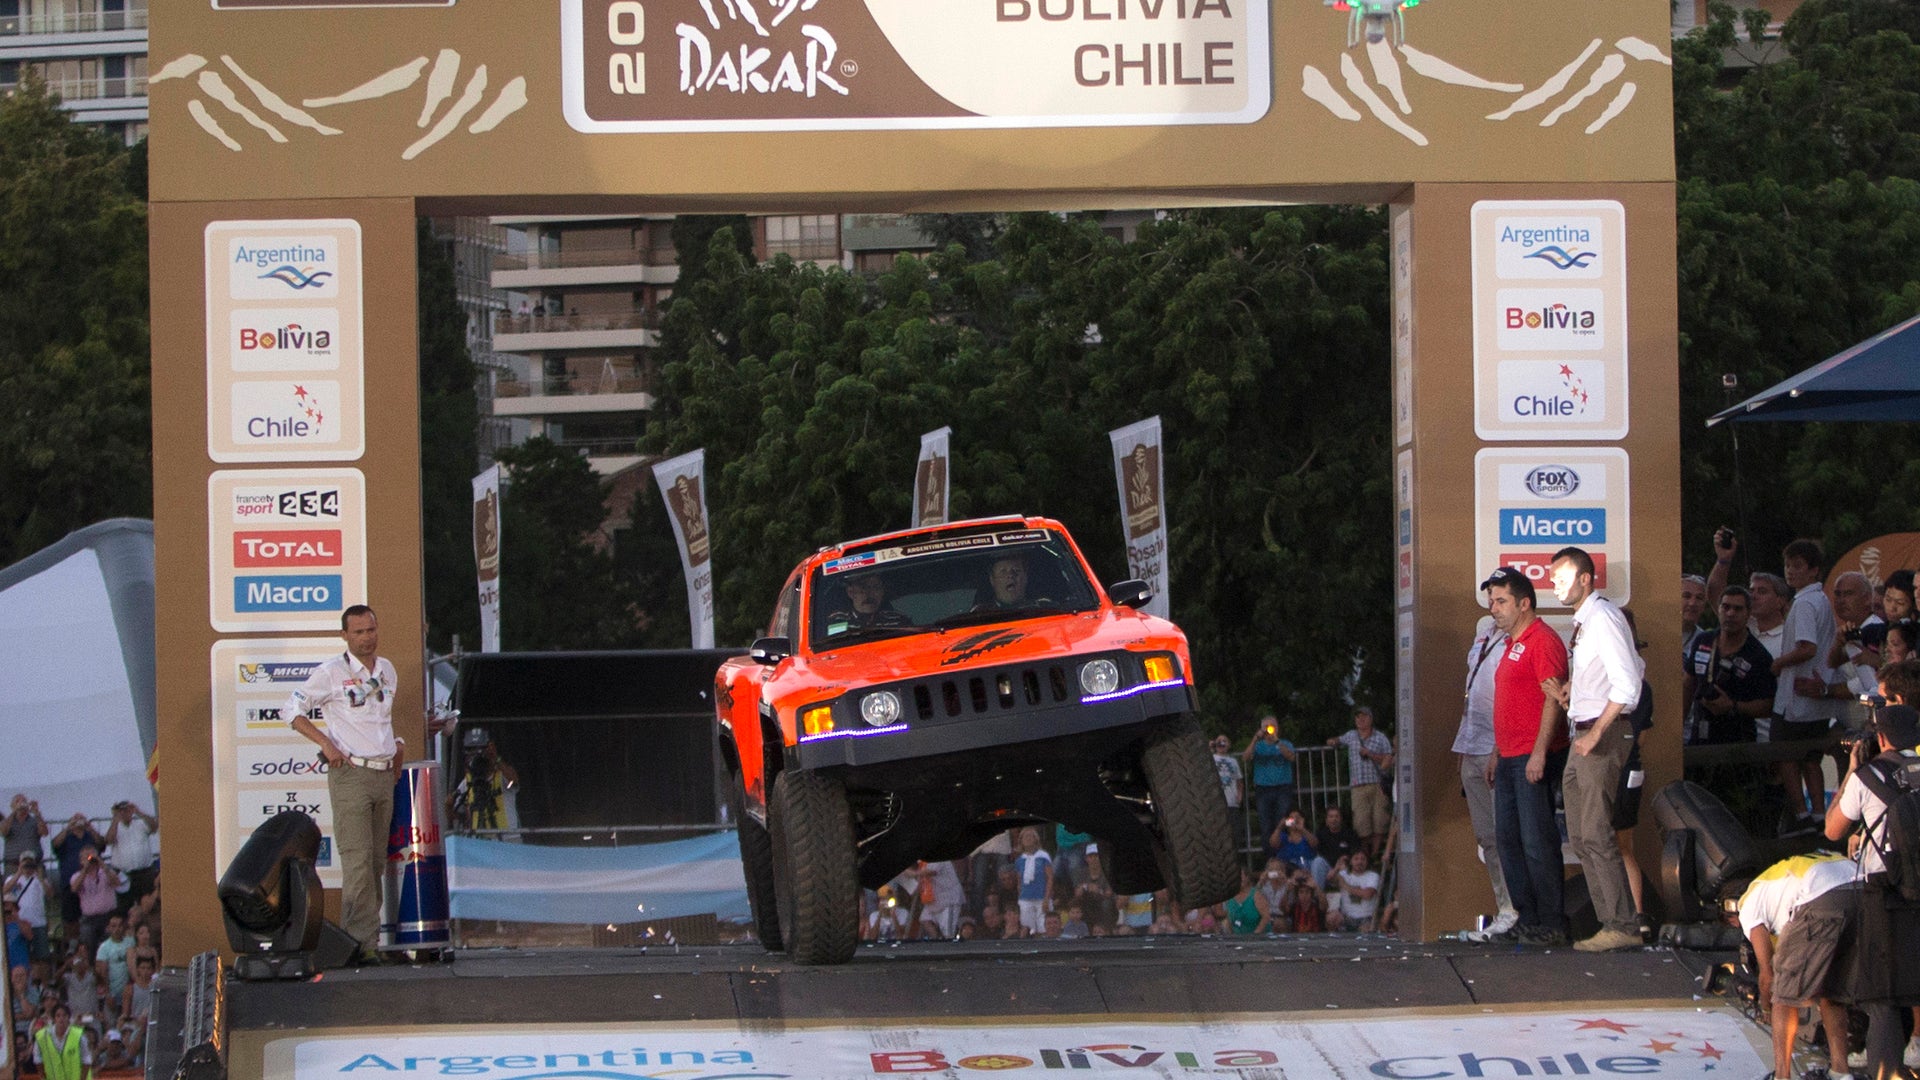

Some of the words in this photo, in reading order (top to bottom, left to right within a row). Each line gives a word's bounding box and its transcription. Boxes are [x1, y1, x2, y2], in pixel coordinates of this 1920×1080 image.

[675, 22, 850, 97] DAKAR
[1073, 41, 1235, 87] CHILE
[1501, 225, 1590, 248] Argentina
[235, 244, 326, 268] Argentina
[1506, 304, 1595, 329] Bolivia
[240, 325, 331, 350] Bolivia
[1513, 395, 1574, 416] Chile
[247, 417, 309, 438] Chile
[1536, 471, 1568, 486] FOX
[236, 503, 274, 517] sport
[1512, 515, 1593, 537] Macro
[241, 538, 334, 558] TOTAL
[247, 582, 330, 604] Macro
[262, 804, 321, 815] EDOX
[339, 1047, 755, 1076] Argentina
[869, 1045, 1279, 1074] Bolivia
[1369, 1052, 1665, 1079] Chile
